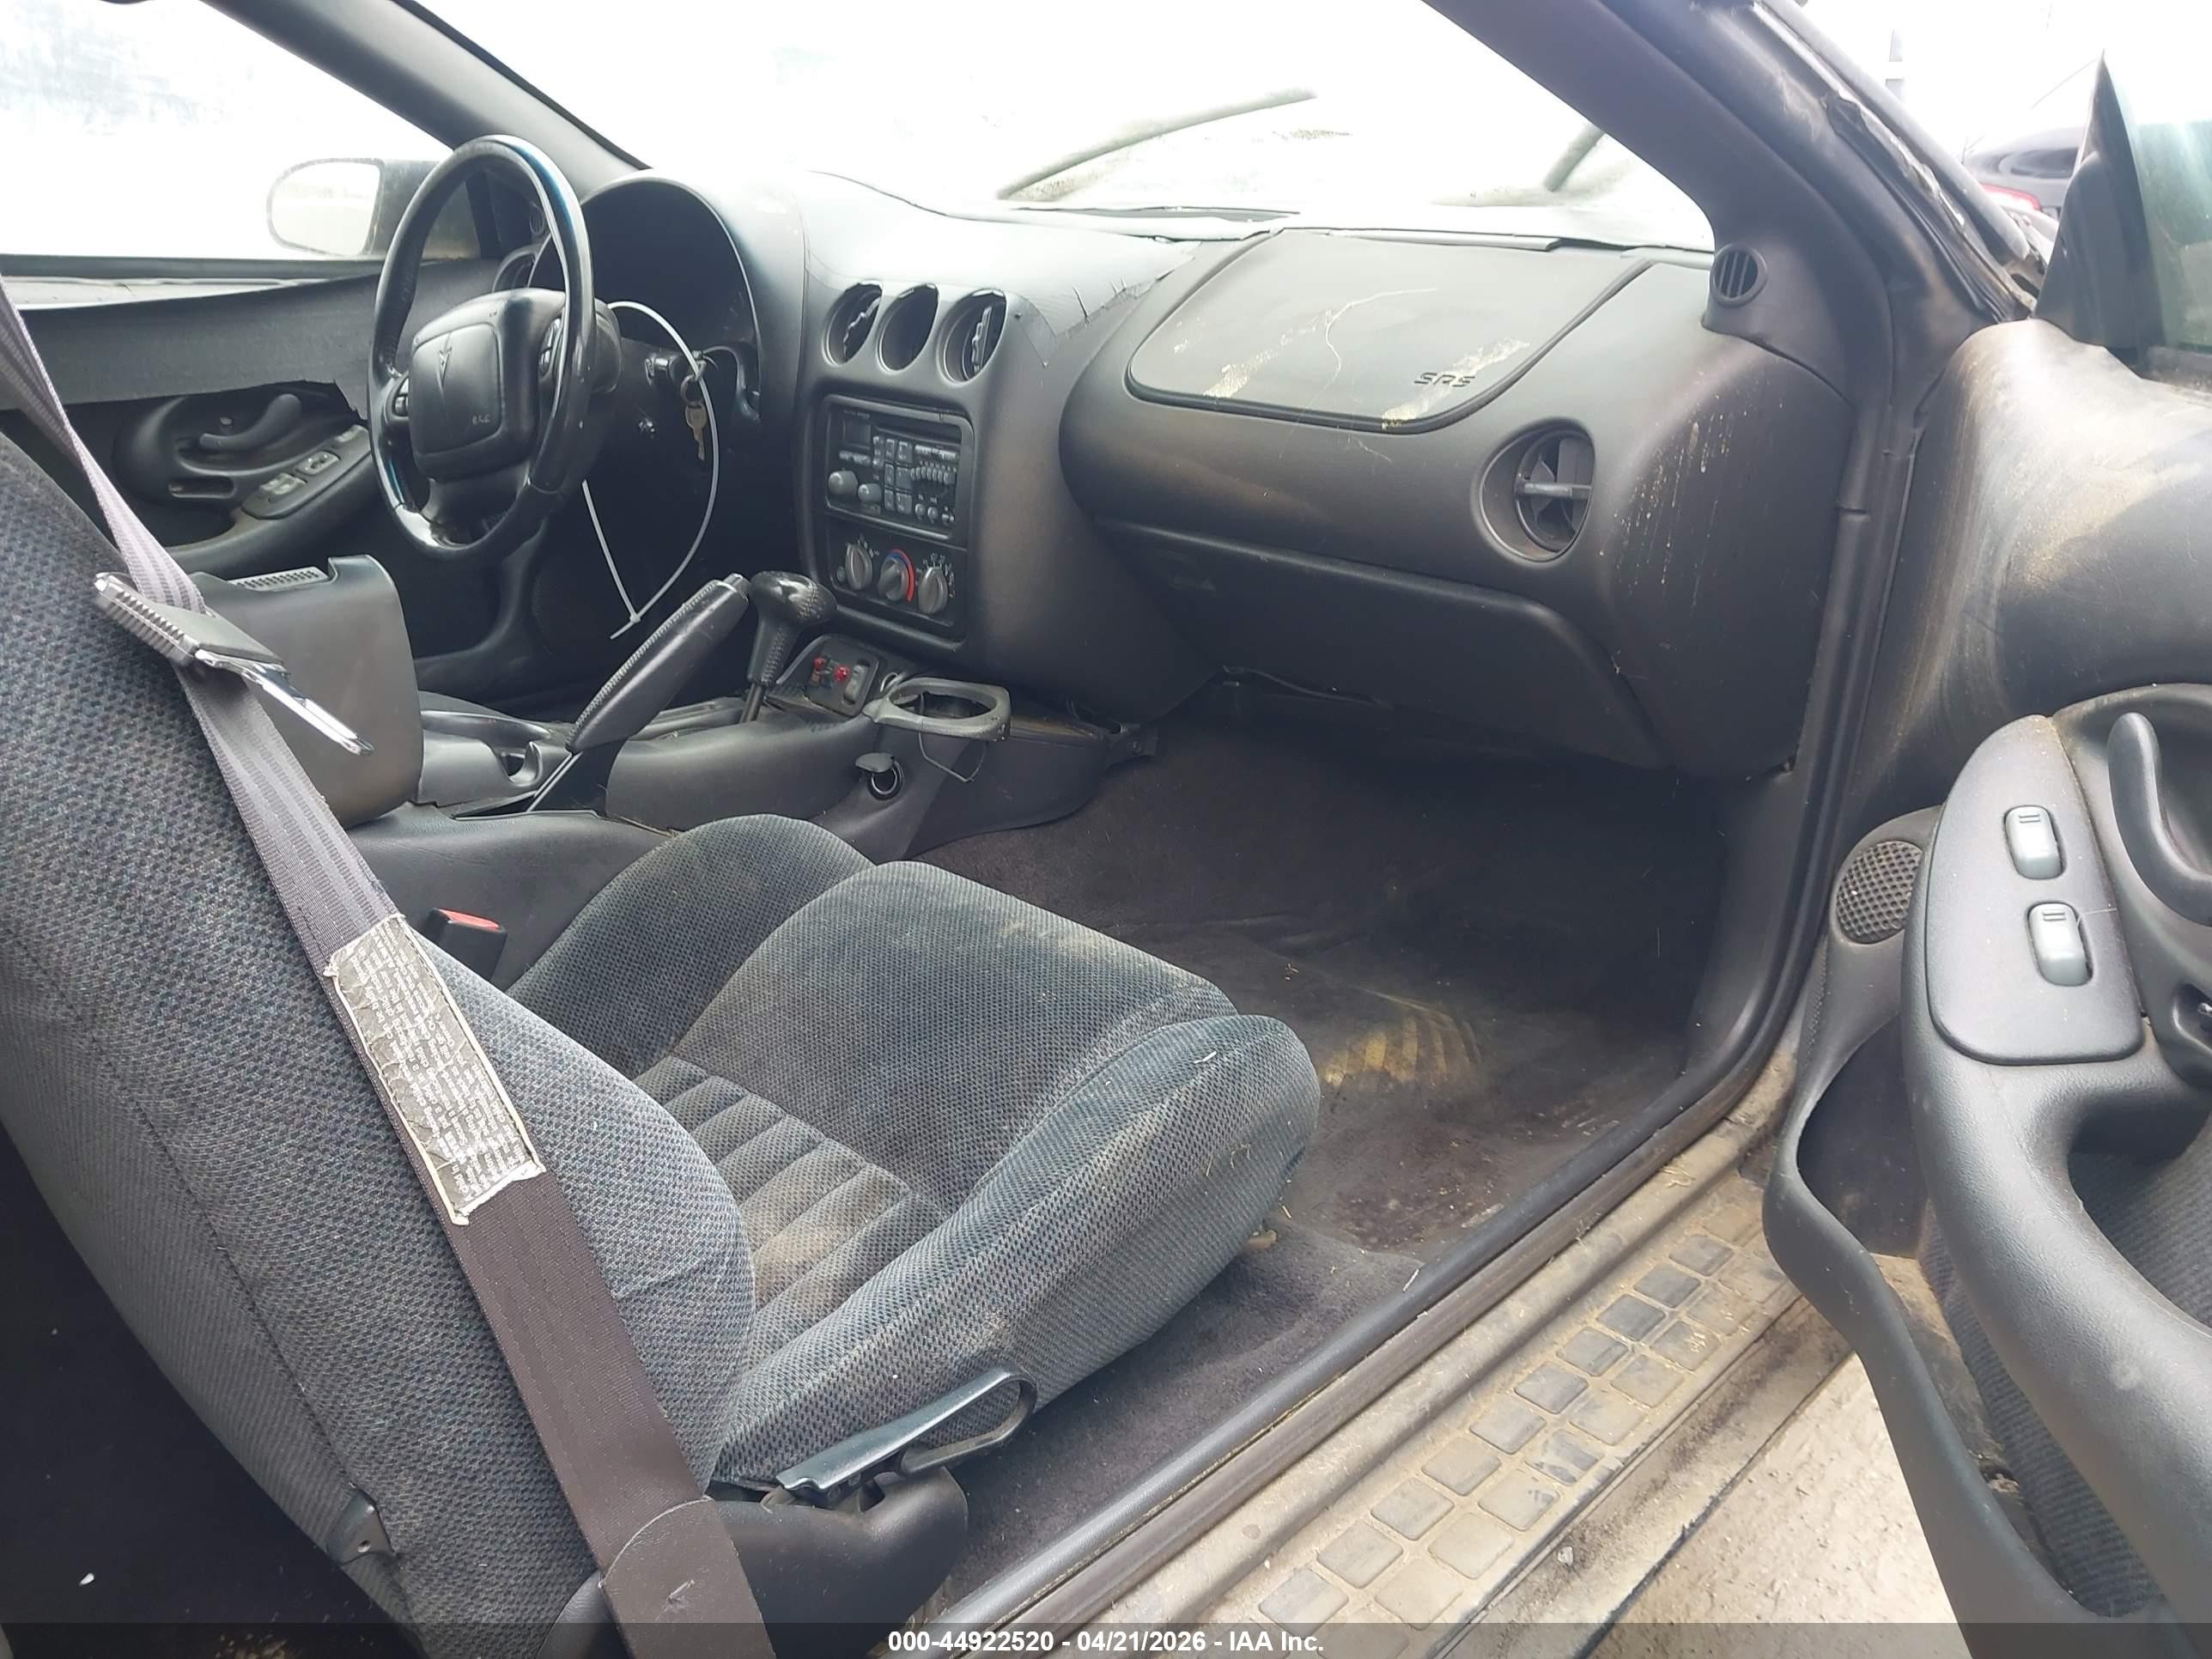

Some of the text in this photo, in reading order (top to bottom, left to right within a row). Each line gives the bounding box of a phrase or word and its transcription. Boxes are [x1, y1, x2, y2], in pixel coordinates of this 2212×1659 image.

[378, 994, 396, 1018] child
[413, 1045, 431, 1069] child
[407, 1081, 428, 1109] child
[421, 1083, 439, 1106] child
[447, 1115, 470, 1146] Secure
[452, 1172, 471, 1195] child
